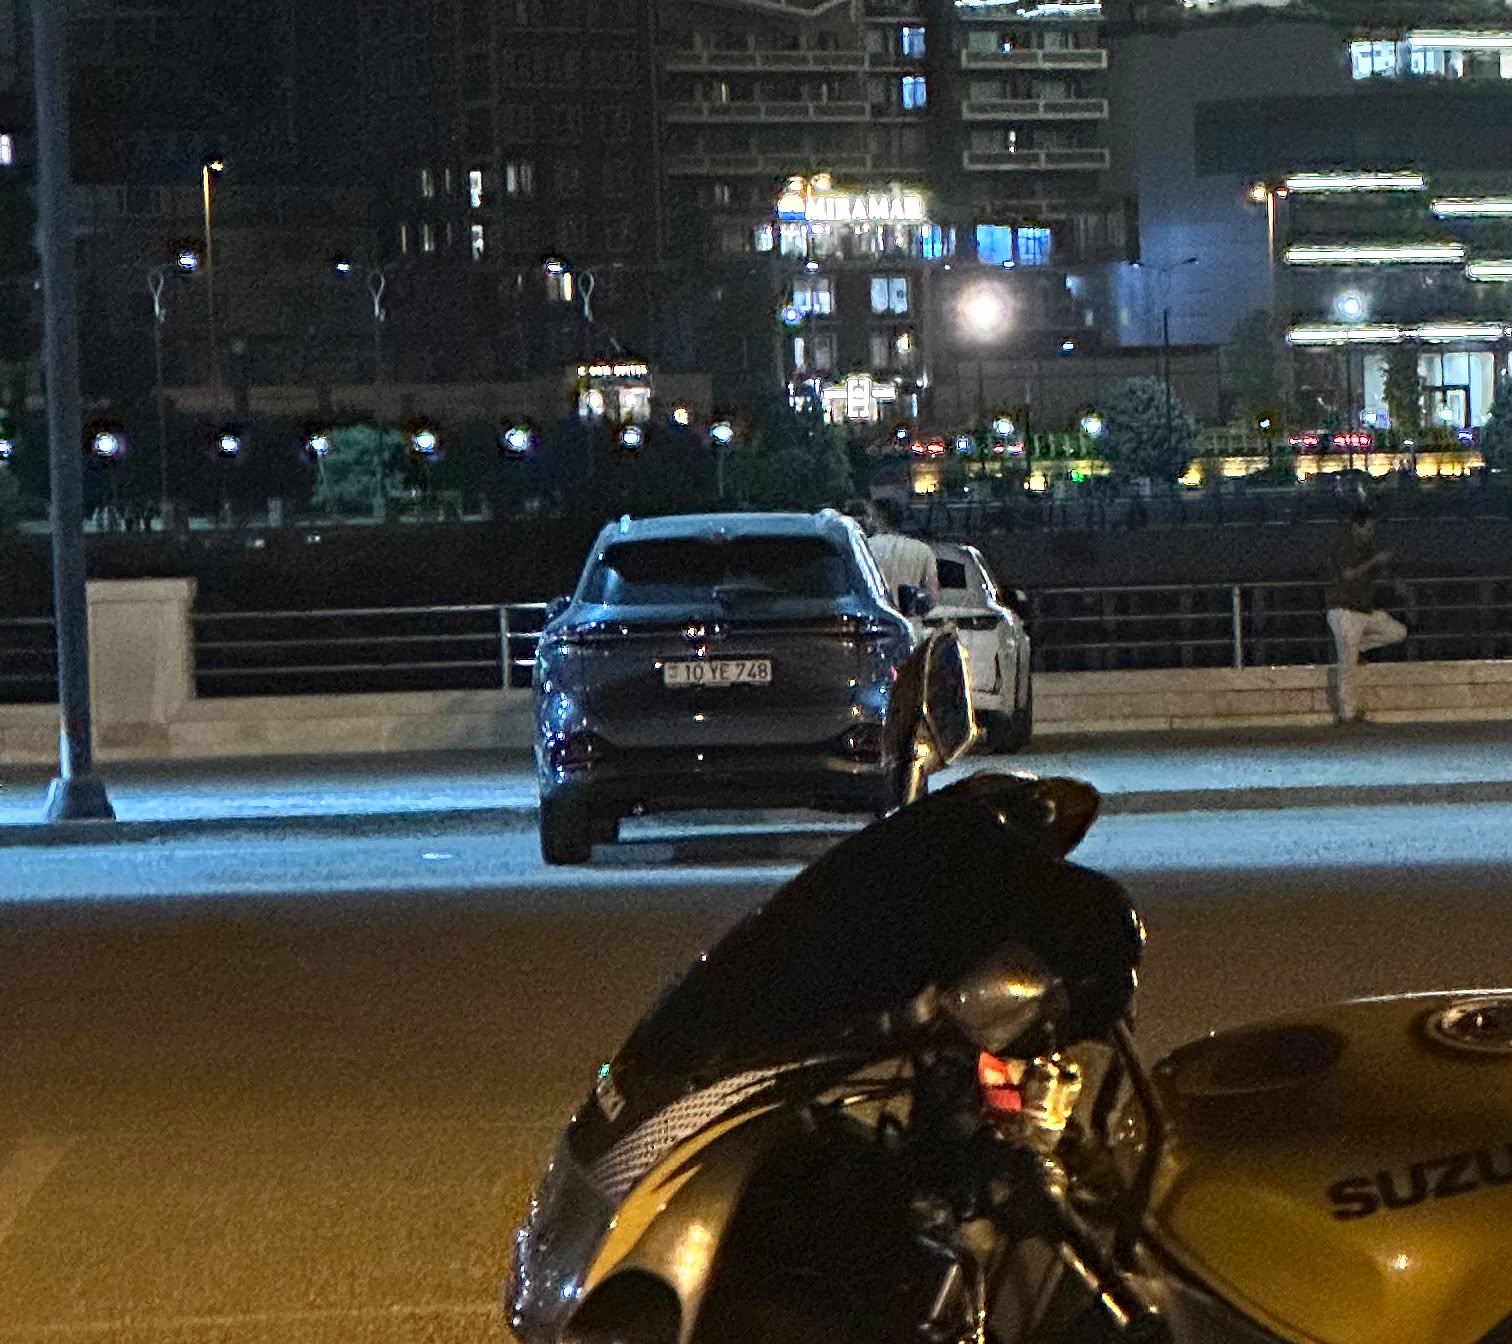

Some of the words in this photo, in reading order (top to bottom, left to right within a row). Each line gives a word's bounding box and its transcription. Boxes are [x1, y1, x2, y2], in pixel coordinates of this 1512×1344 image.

[685, 664, 704, 681] 10
[710, 663, 729, 680] YE
[735, 662, 769, 680] 748
